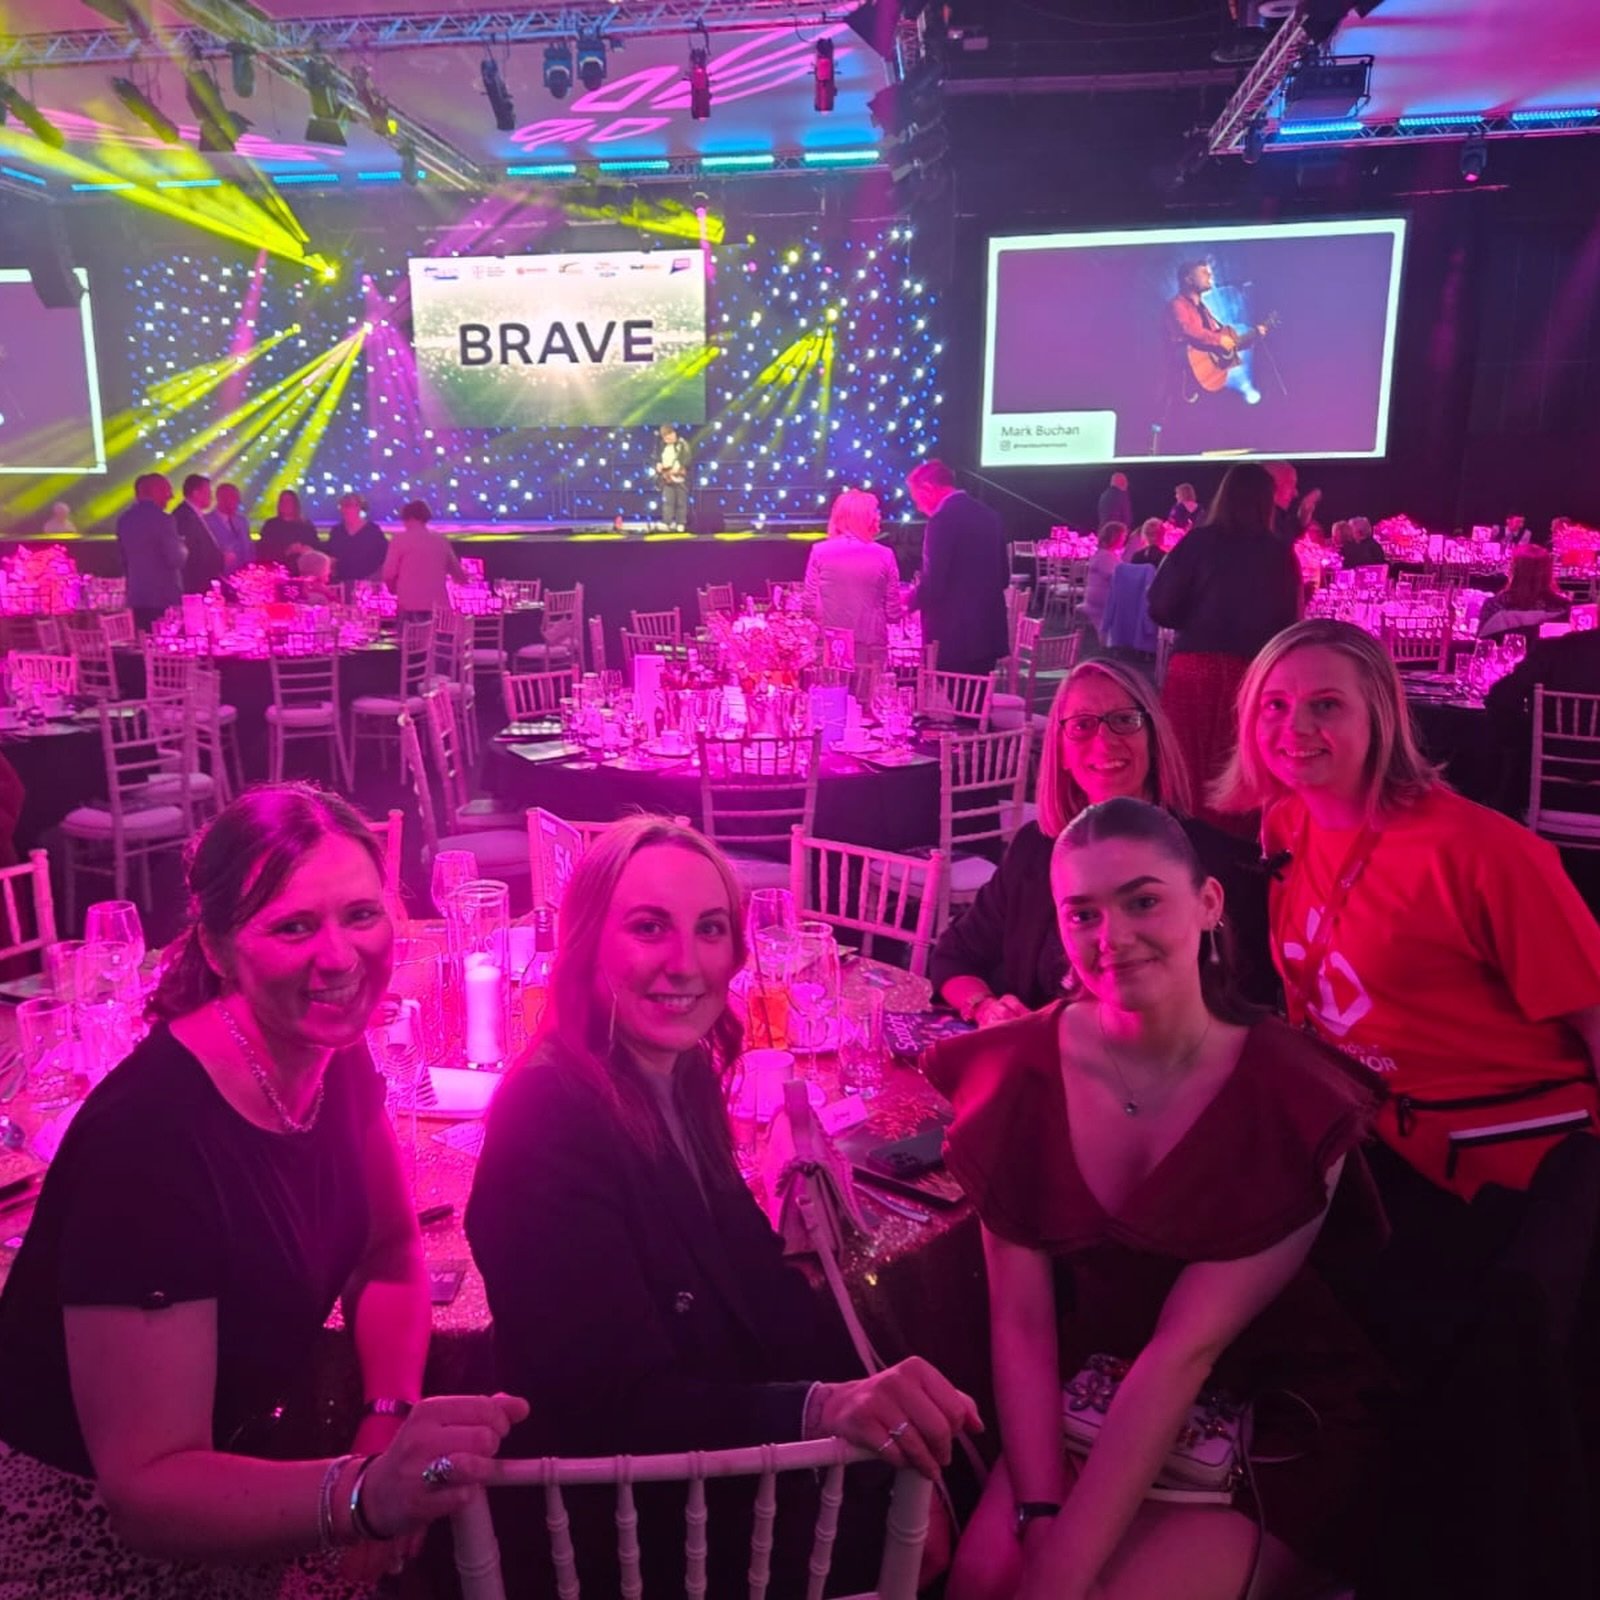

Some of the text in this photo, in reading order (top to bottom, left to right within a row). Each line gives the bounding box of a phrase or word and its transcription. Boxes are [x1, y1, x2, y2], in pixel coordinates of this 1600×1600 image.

[459, 319, 654, 366] BRAVE
[1001, 424, 1080, 437] Mark Buchan
